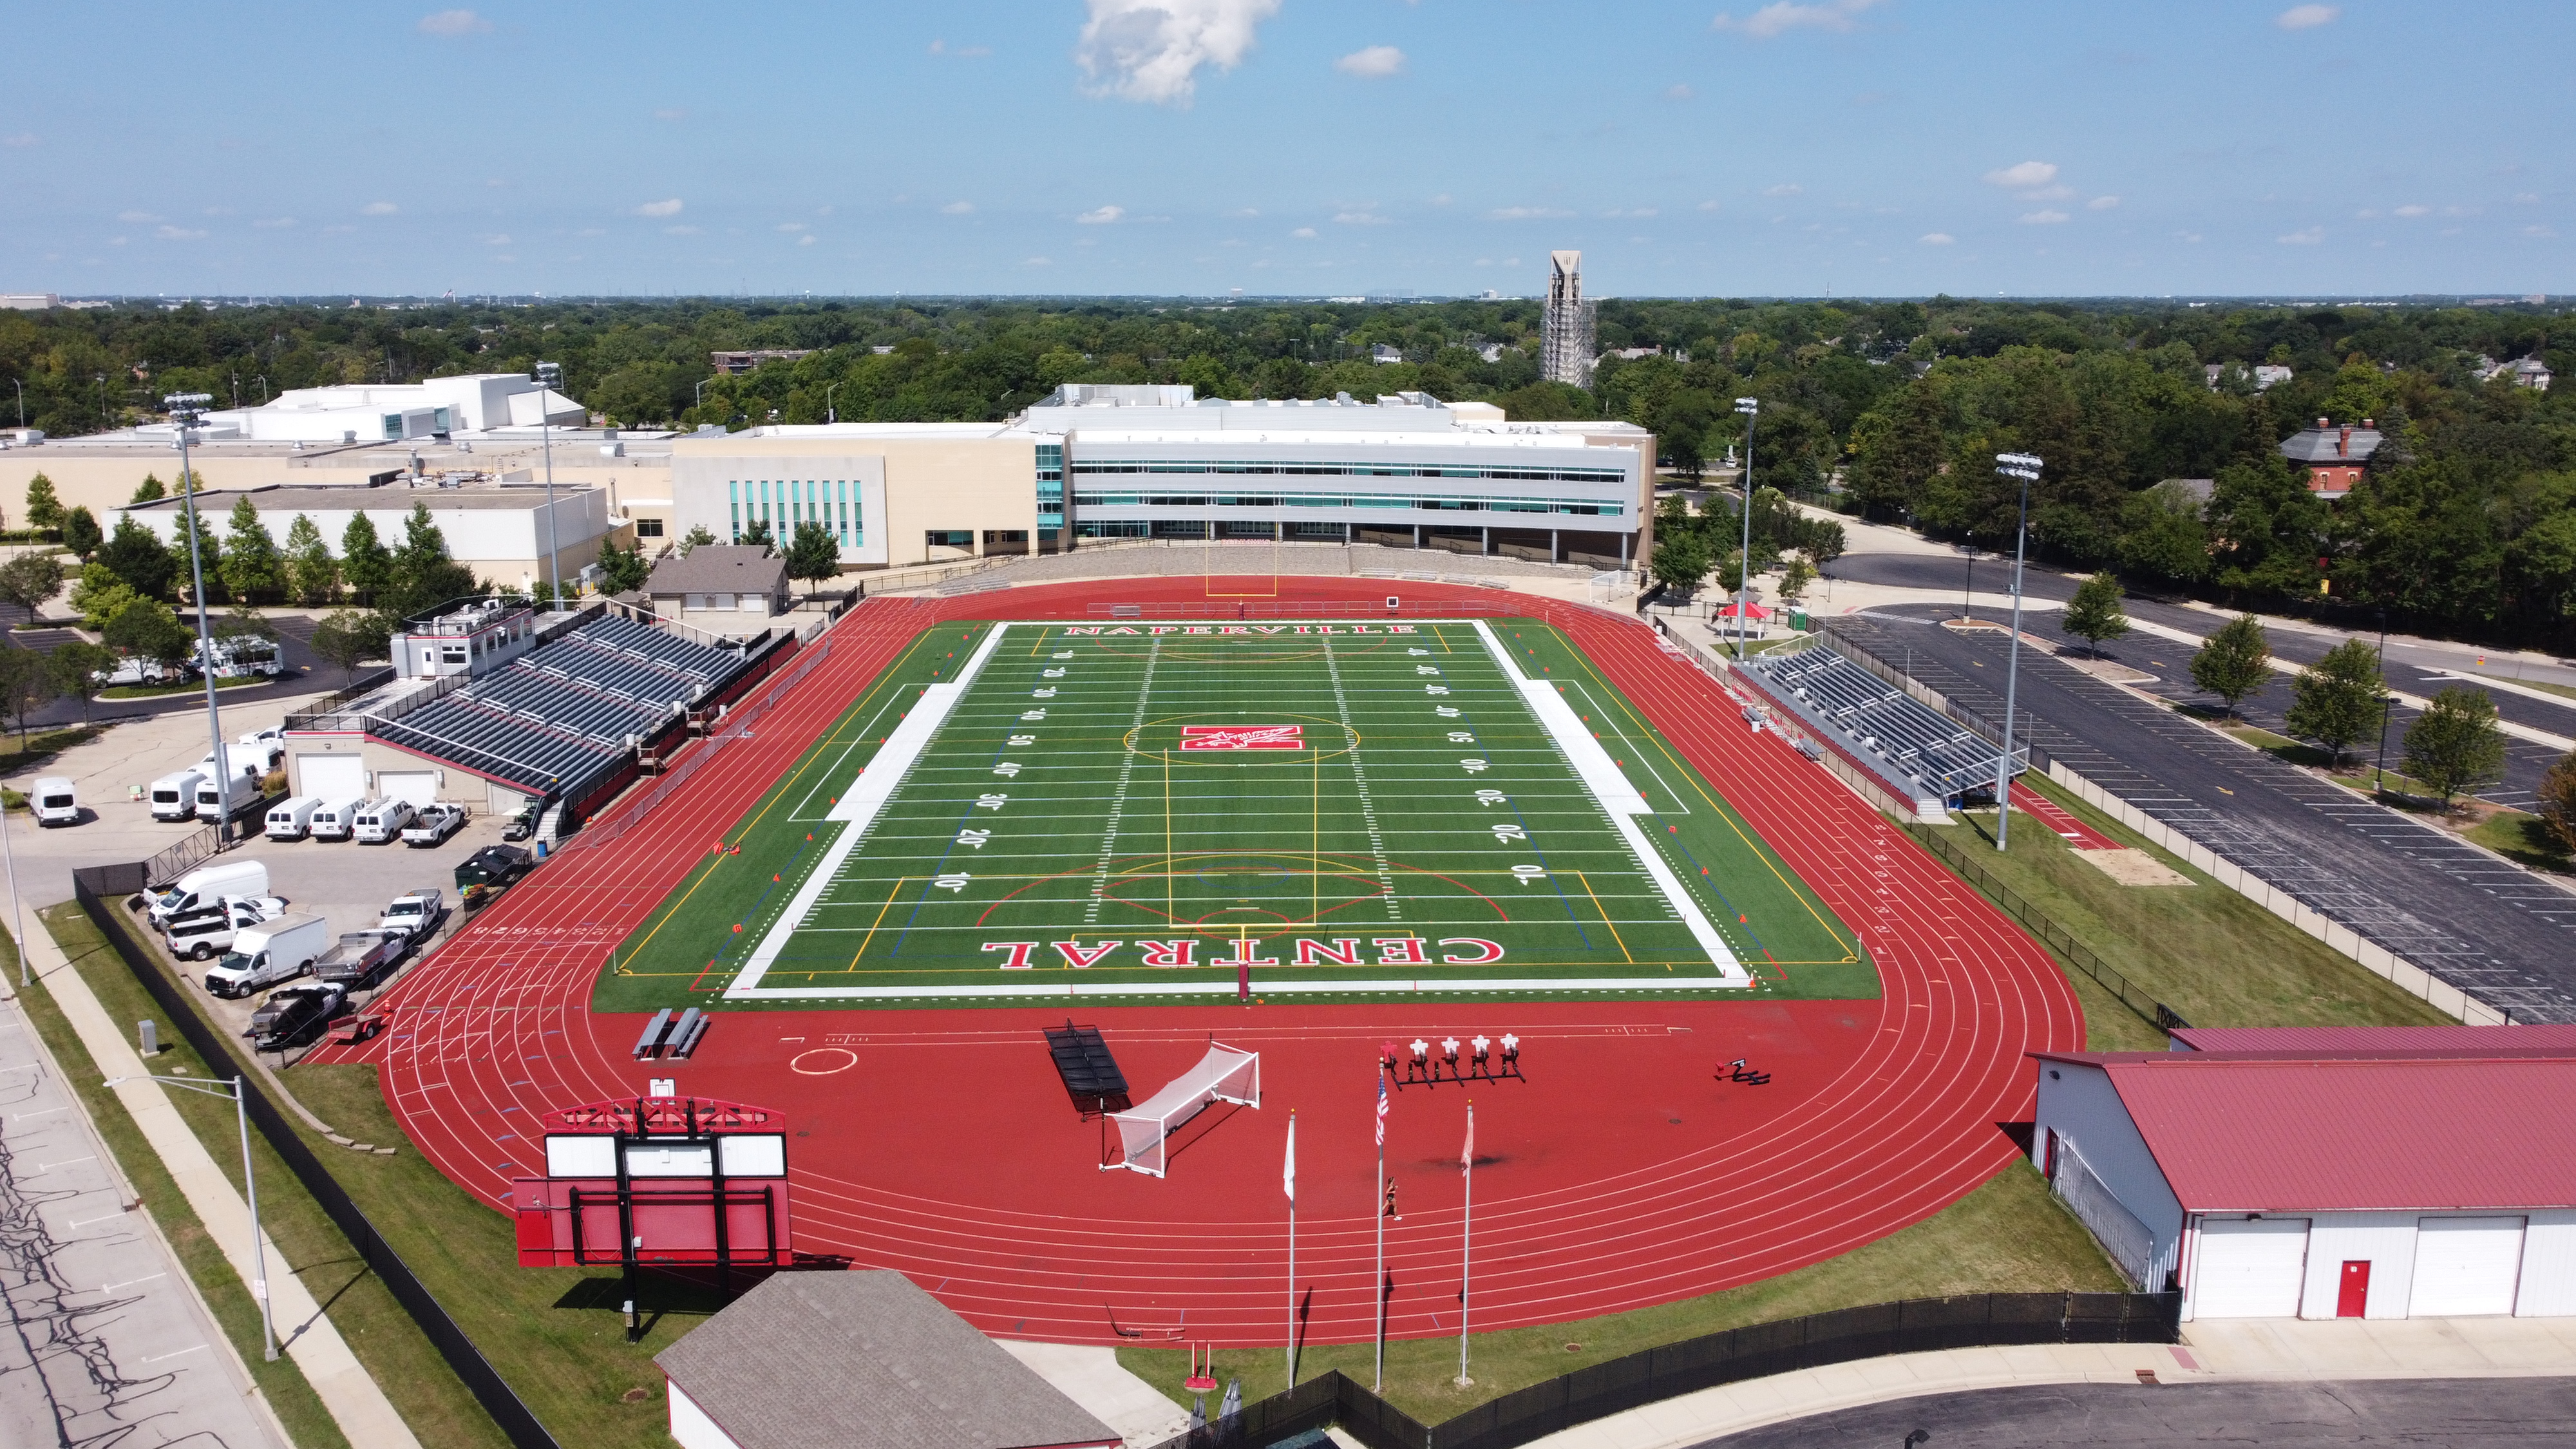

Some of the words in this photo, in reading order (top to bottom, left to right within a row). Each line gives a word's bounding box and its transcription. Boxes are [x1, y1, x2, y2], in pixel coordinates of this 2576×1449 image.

[1064, 626, 1417, 636] NAPERVILLE
[1020, 709, 1046, 721] 40
[1435, 707, 1461, 717] 40
[1007, 735, 1036, 746] 50
[1447, 732, 1475, 743] 50
[992, 762, 1021, 774] 40
[1460, 759, 1489, 772] 40
[976, 793, 1007, 808] 30
[1475, 789, 1508, 804] 30
[956, 829, 990, 845] 20
[1492, 824, 1526, 841] 20
[934, 872, 971, 889] 10
[1511, 865, 1546, 882] 10
[981, 936, 1505, 969] CENTRAL
